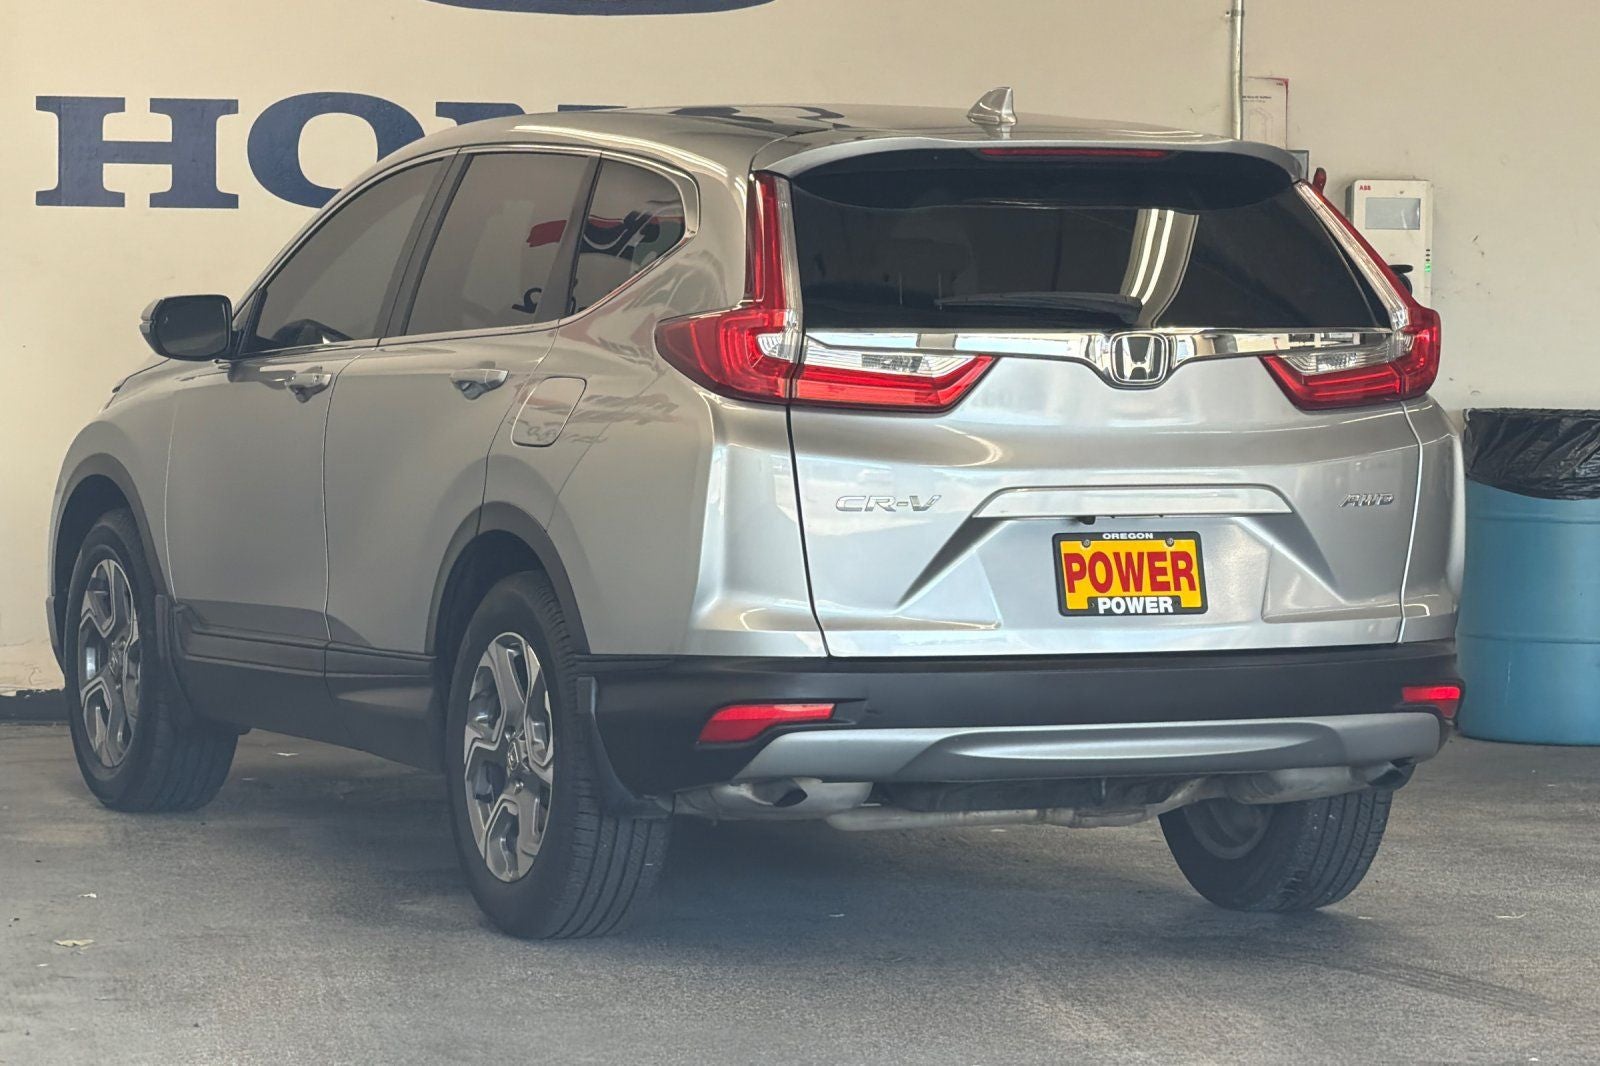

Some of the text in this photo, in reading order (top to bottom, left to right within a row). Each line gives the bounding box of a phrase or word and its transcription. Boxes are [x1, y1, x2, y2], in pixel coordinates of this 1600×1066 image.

[836, 494, 942, 512] CR-V
[1337, 493, 1395, 507] AWD
[1102, 532, 1154, 540] OREGON
[1063, 550, 1197, 594] POWER
[1097, 596, 1174, 614] POWER
